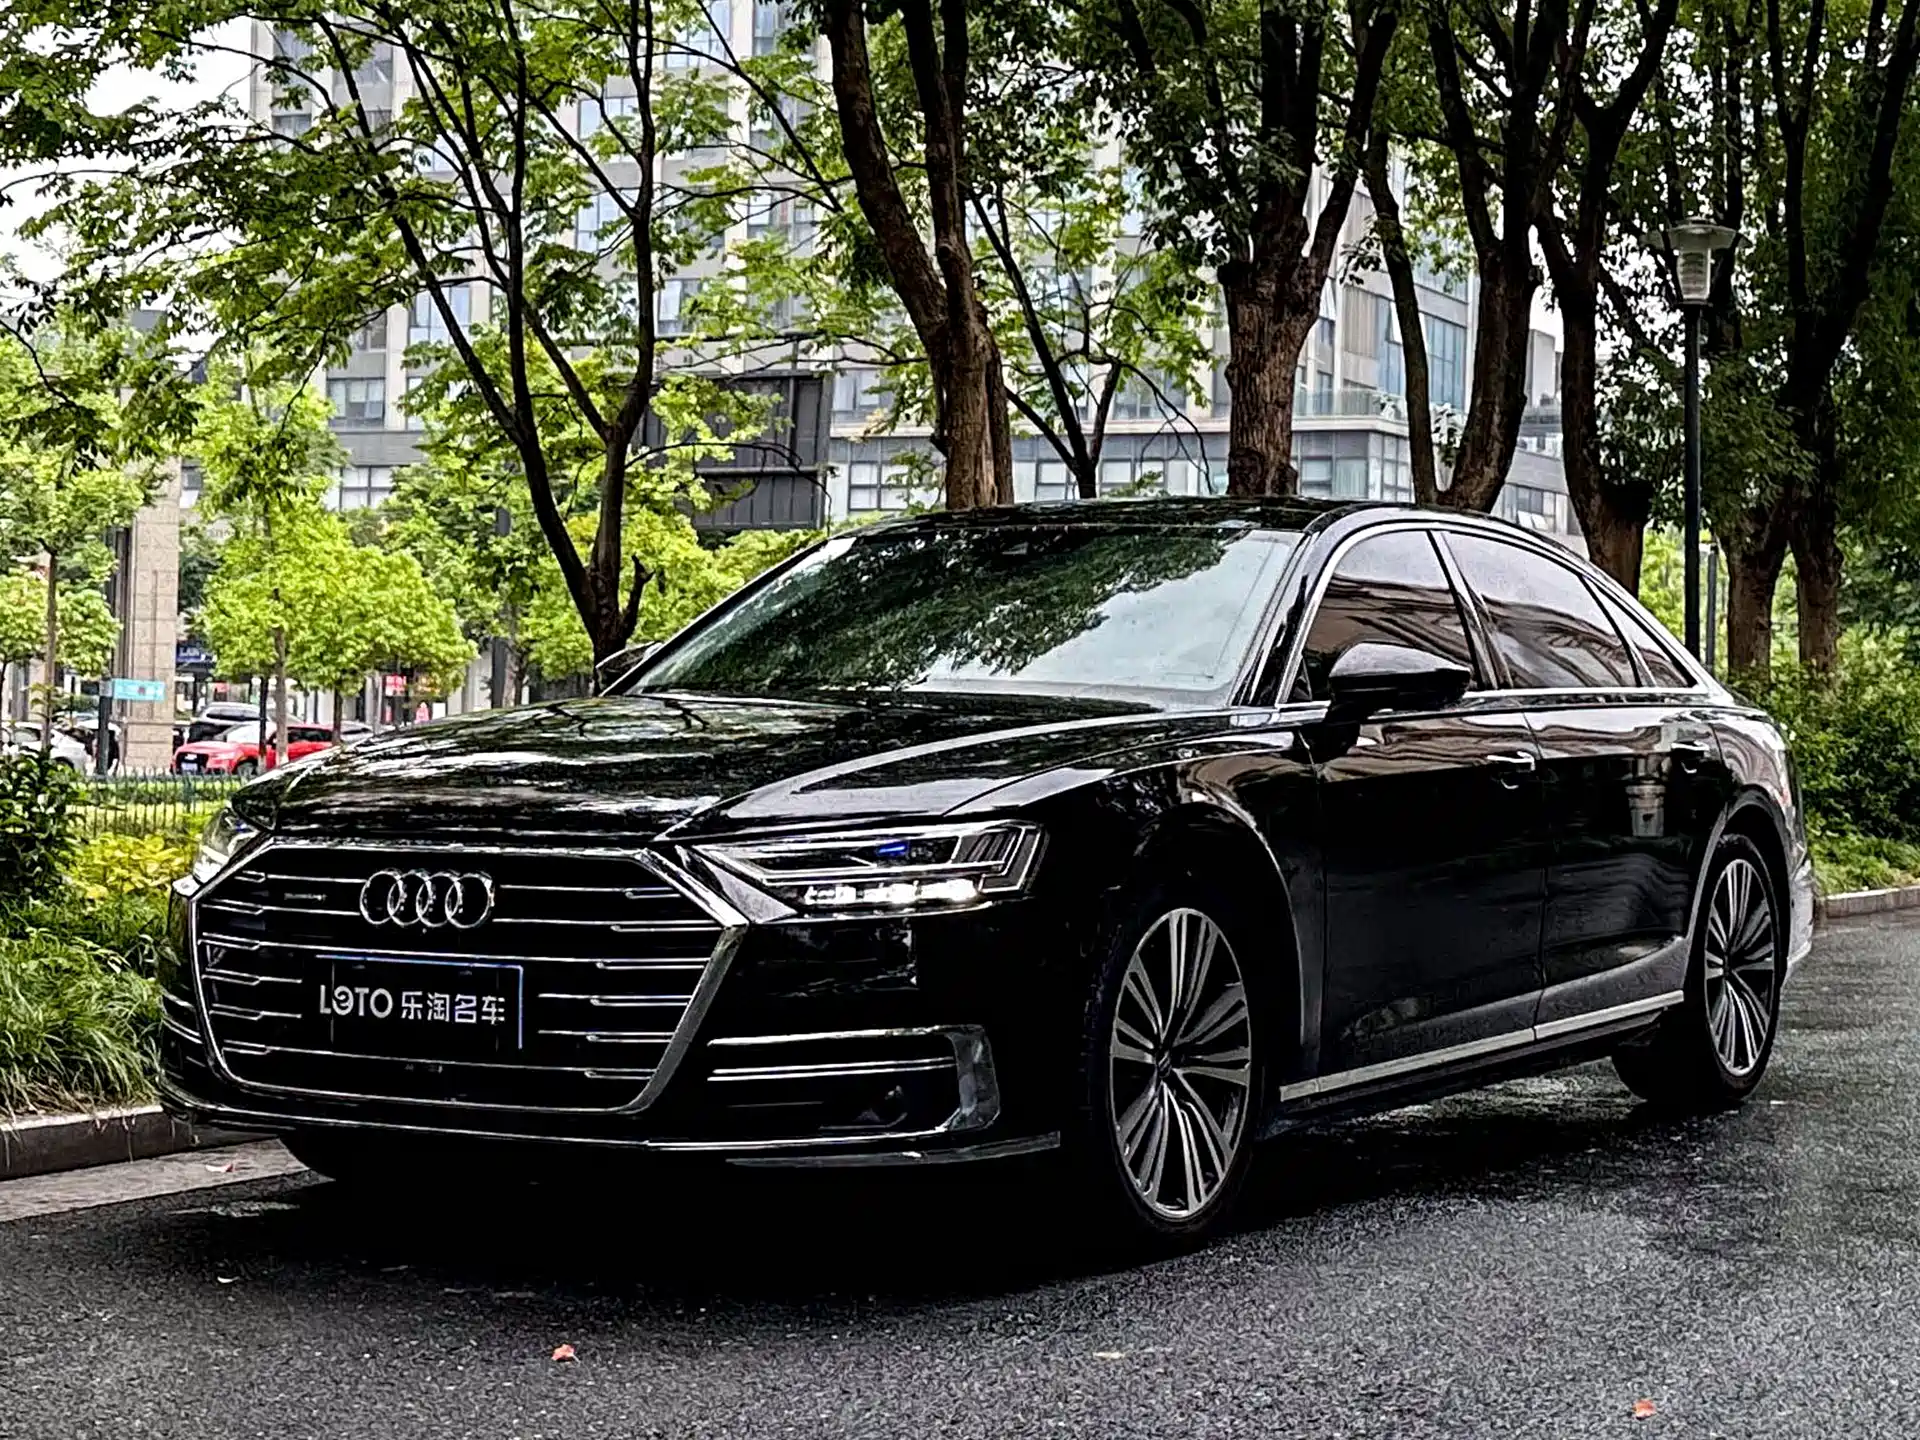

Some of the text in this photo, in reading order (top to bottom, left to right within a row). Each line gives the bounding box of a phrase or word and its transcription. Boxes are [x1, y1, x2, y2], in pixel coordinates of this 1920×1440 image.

[319, 984, 505, 1025] LOTO 乐淘名车
